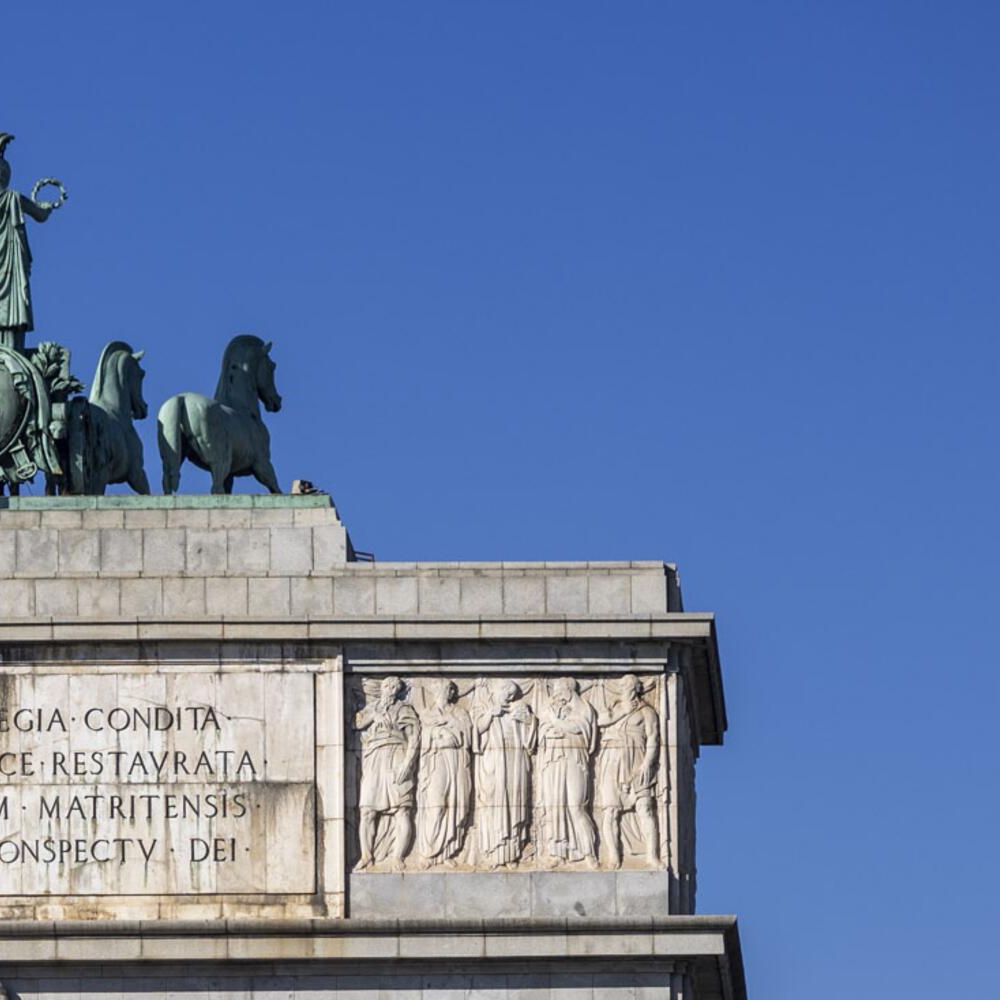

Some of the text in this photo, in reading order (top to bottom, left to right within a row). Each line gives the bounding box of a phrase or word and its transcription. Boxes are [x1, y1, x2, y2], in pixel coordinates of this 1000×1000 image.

[83, 706, 222, 732] CONDITA
[52, 750, 257, 777] RESTAVRATA
[38, 793, 247, 820] MATRITENSIS
[189, 837, 237, 863] DEI
